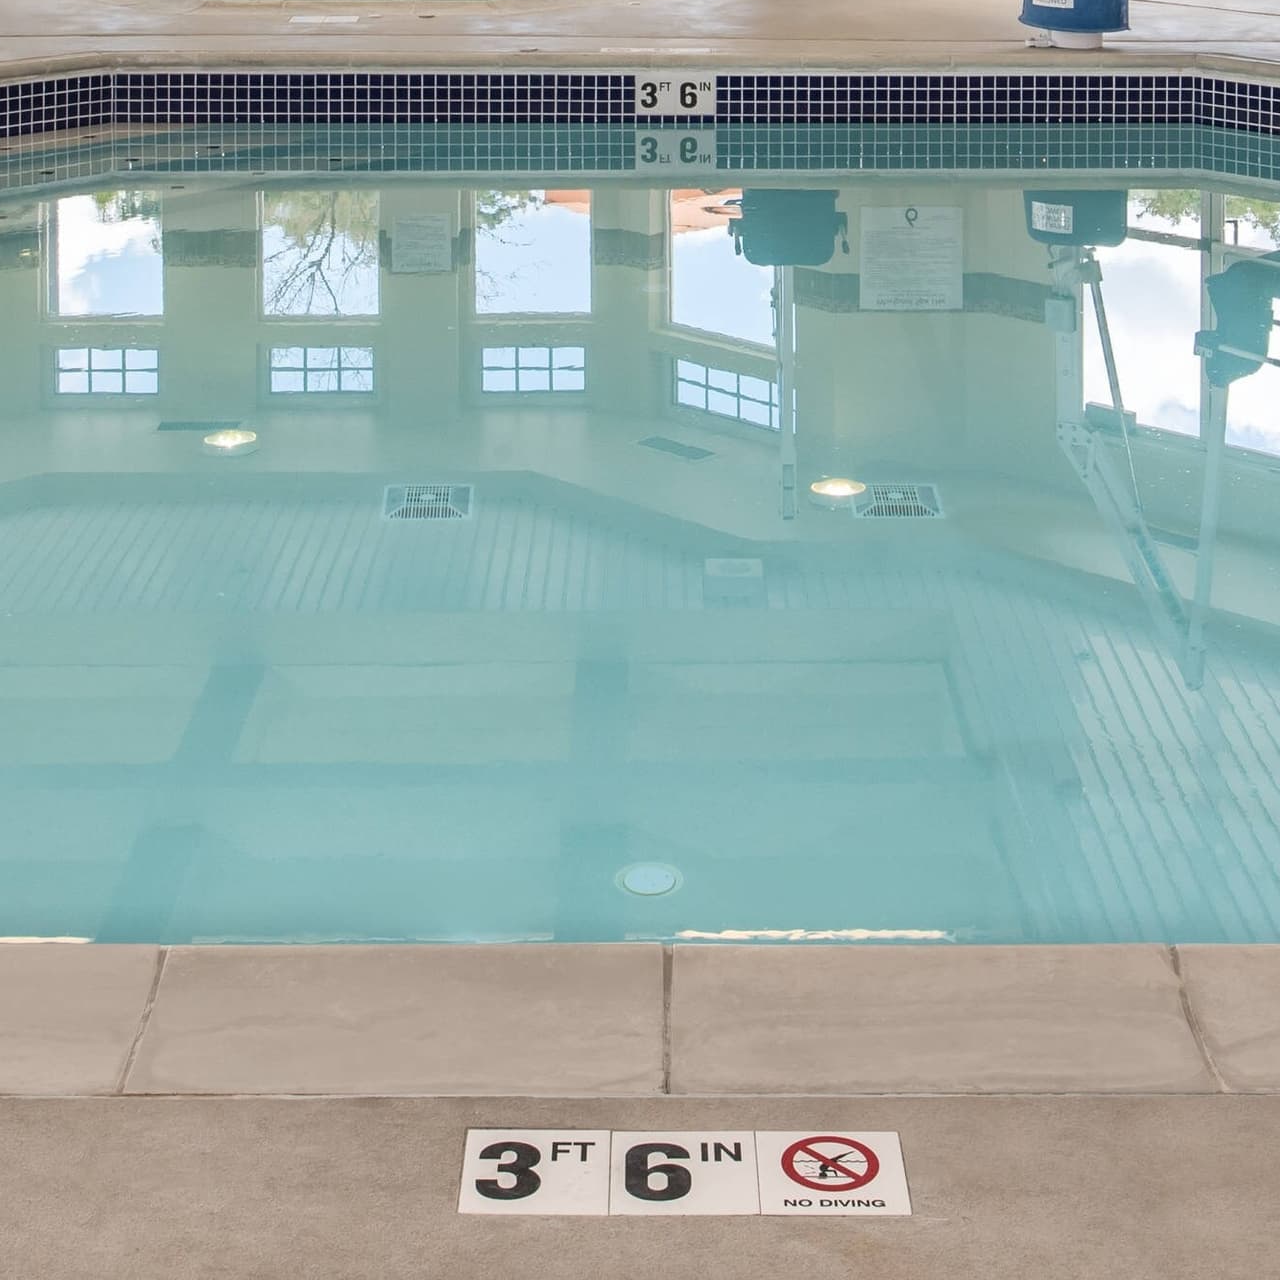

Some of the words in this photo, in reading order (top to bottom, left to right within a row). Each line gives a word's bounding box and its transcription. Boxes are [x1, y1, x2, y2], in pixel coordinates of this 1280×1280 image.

[641, 82, 658, 108] 3
[659, 82, 672, 91] FT
[680, 82, 697, 108] 6
[700, 82, 711, 91] IN
[475, 1140, 542, 1201] 3
[550, 1141, 596, 1162] FT
[624, 1142, 692, 1202] 6
[700, 1141, 743, 1162] IN
[783, 1198, 813, 1208] NO
[819, 1198, 886, 1208] DIVING
